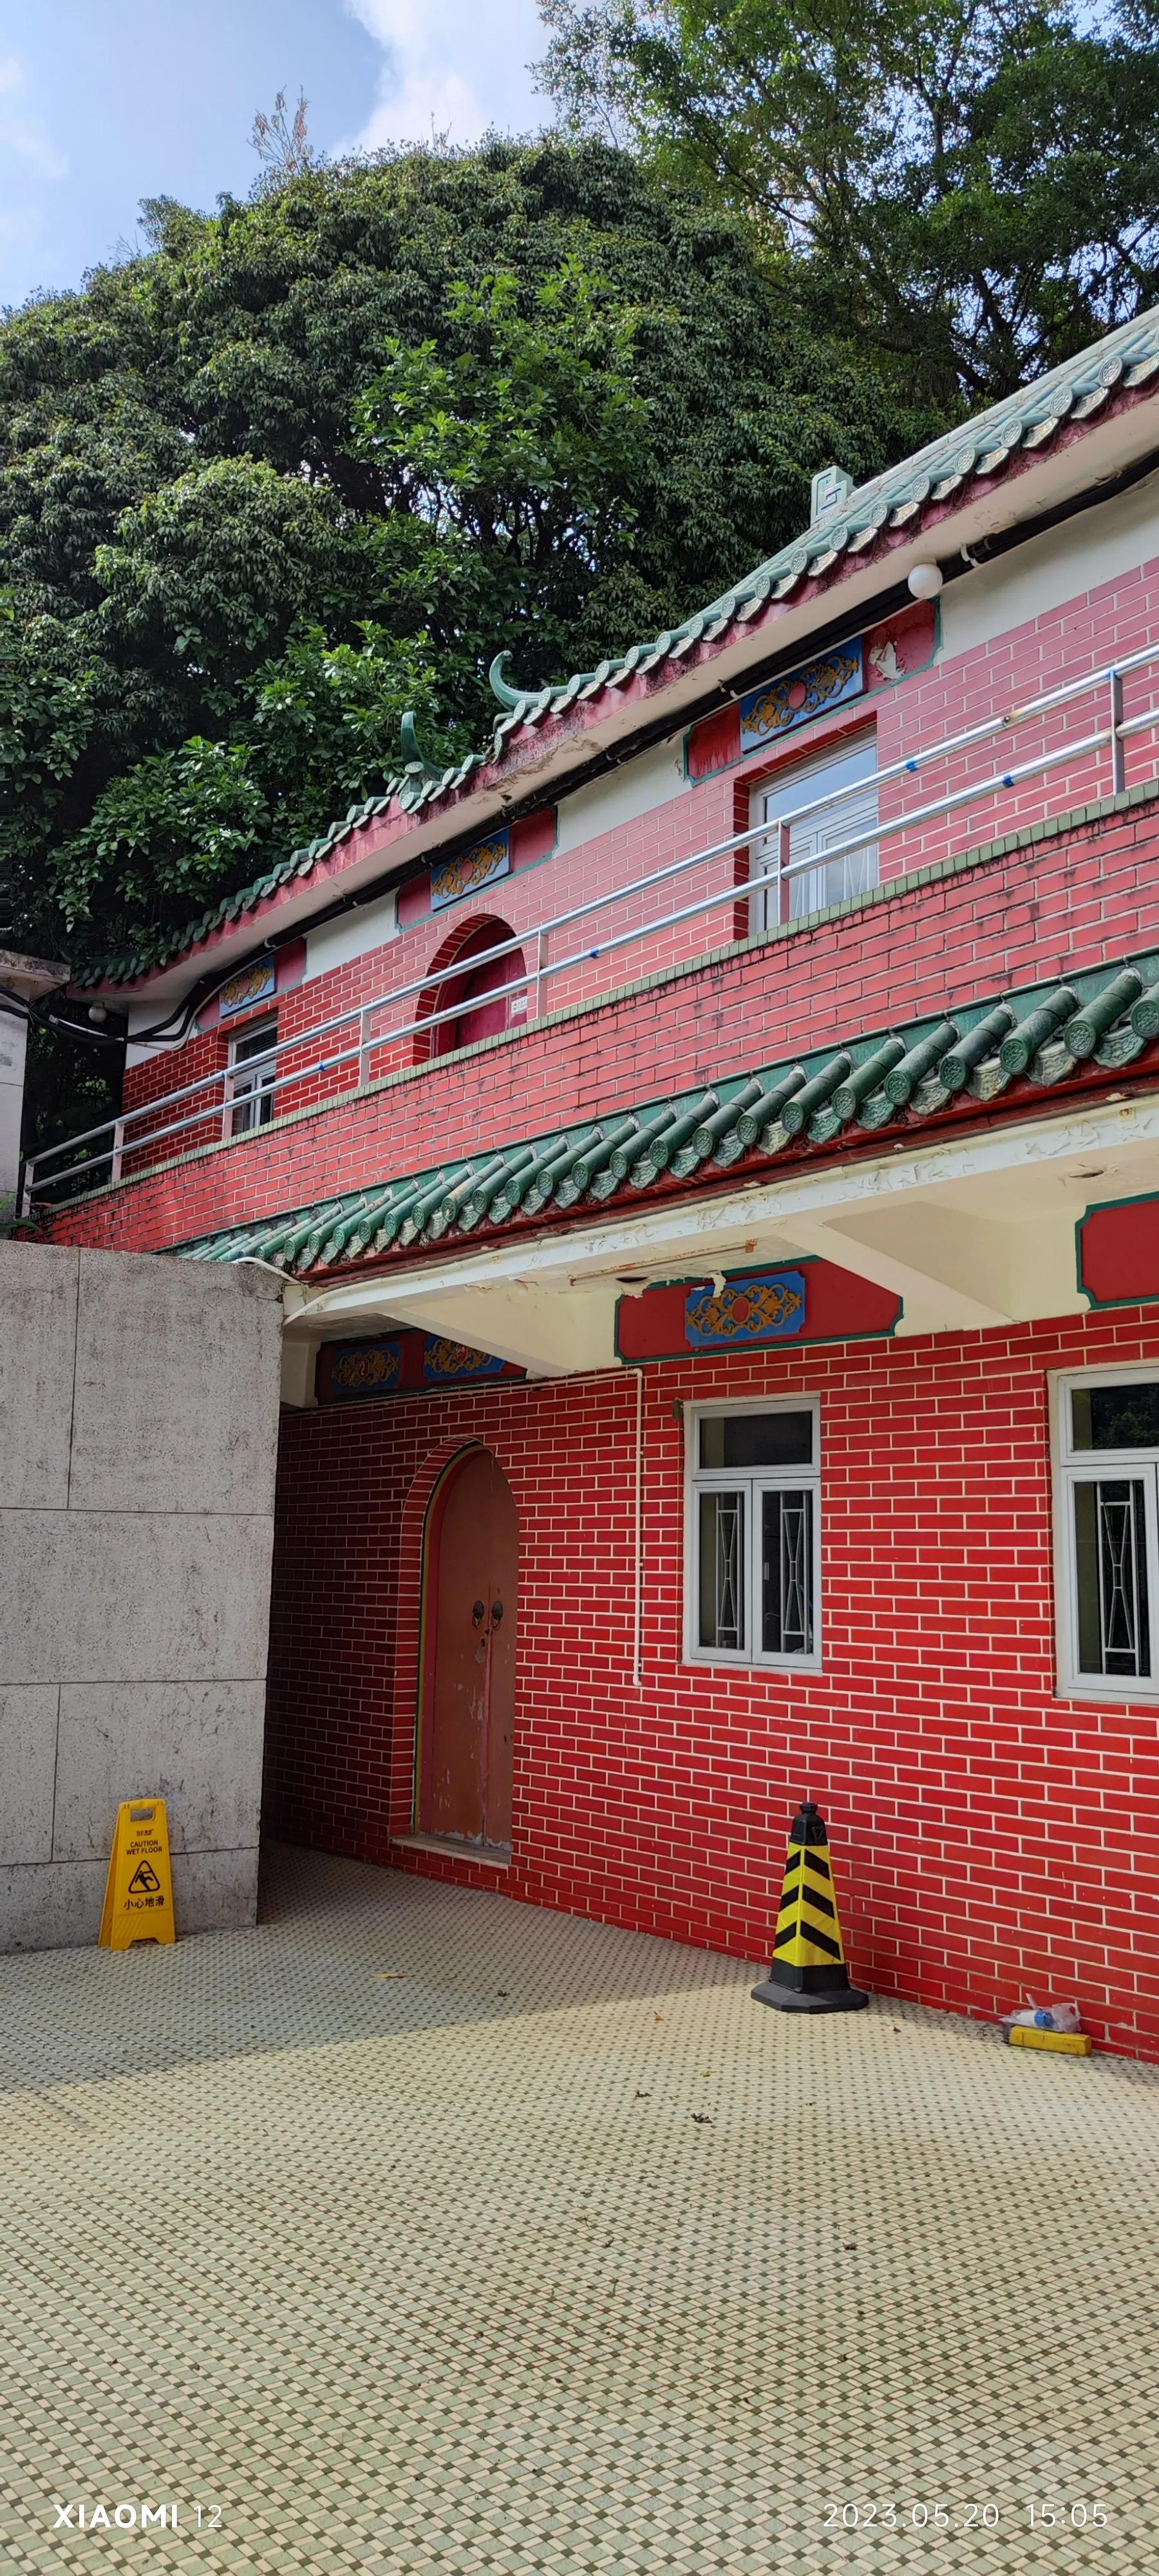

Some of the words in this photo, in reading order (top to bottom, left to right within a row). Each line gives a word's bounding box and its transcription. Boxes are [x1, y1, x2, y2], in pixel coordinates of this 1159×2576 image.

[130, 1839, 158, 1848] CAUTION
[141, 1846, 162, 1854] FLOOR
[124, 1895, 165, 1910] 小心地滑
